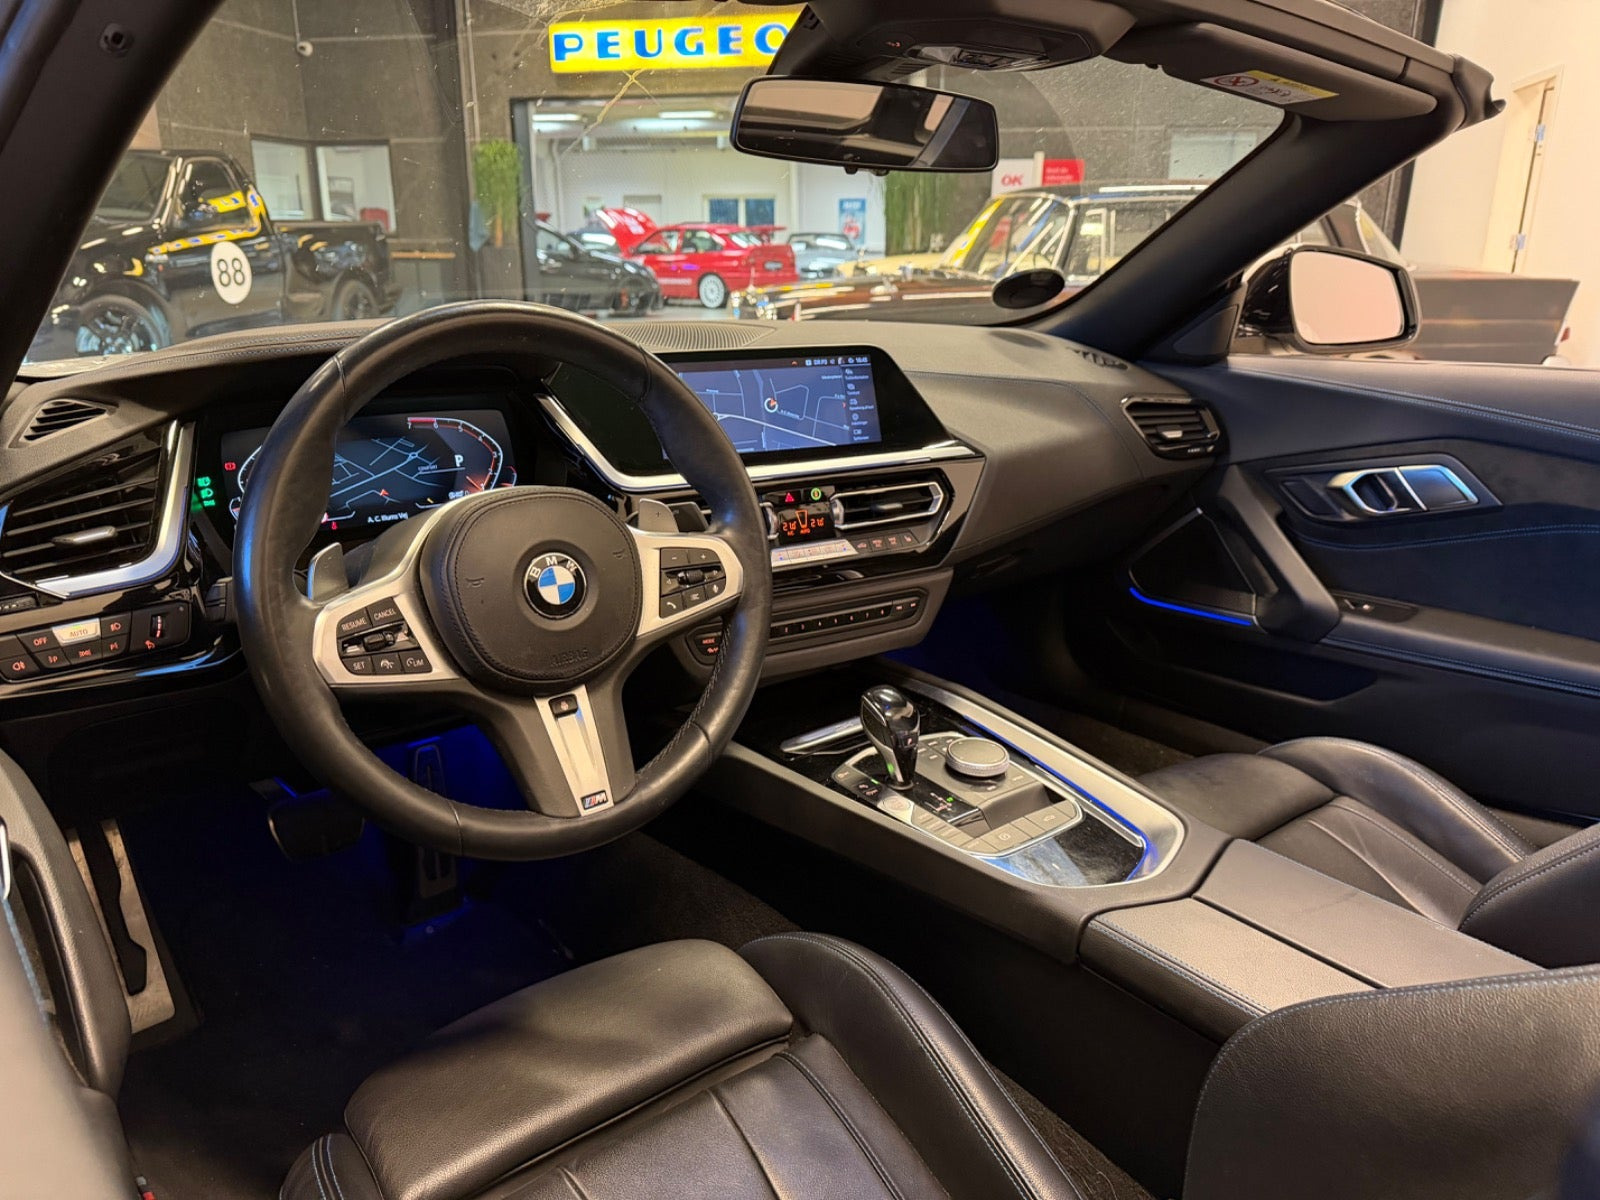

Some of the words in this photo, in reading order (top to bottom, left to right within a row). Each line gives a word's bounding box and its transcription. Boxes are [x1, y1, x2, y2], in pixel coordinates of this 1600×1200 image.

[1001, 173, 1024, 186] OK
[217, 257, 246, 288] 88
[455, 455, 465, 467] P
[529, 555, 579, 579] BMW
[373, 608, 396, 621] CANCEL
[341, 616, 368, 632] RESUME
[70, 630, 88, 638] AUTO
[34, 637, 48, 646] OFF
[353, 661, 365, 671] SET
[412, 659, 424, 668] LIM
